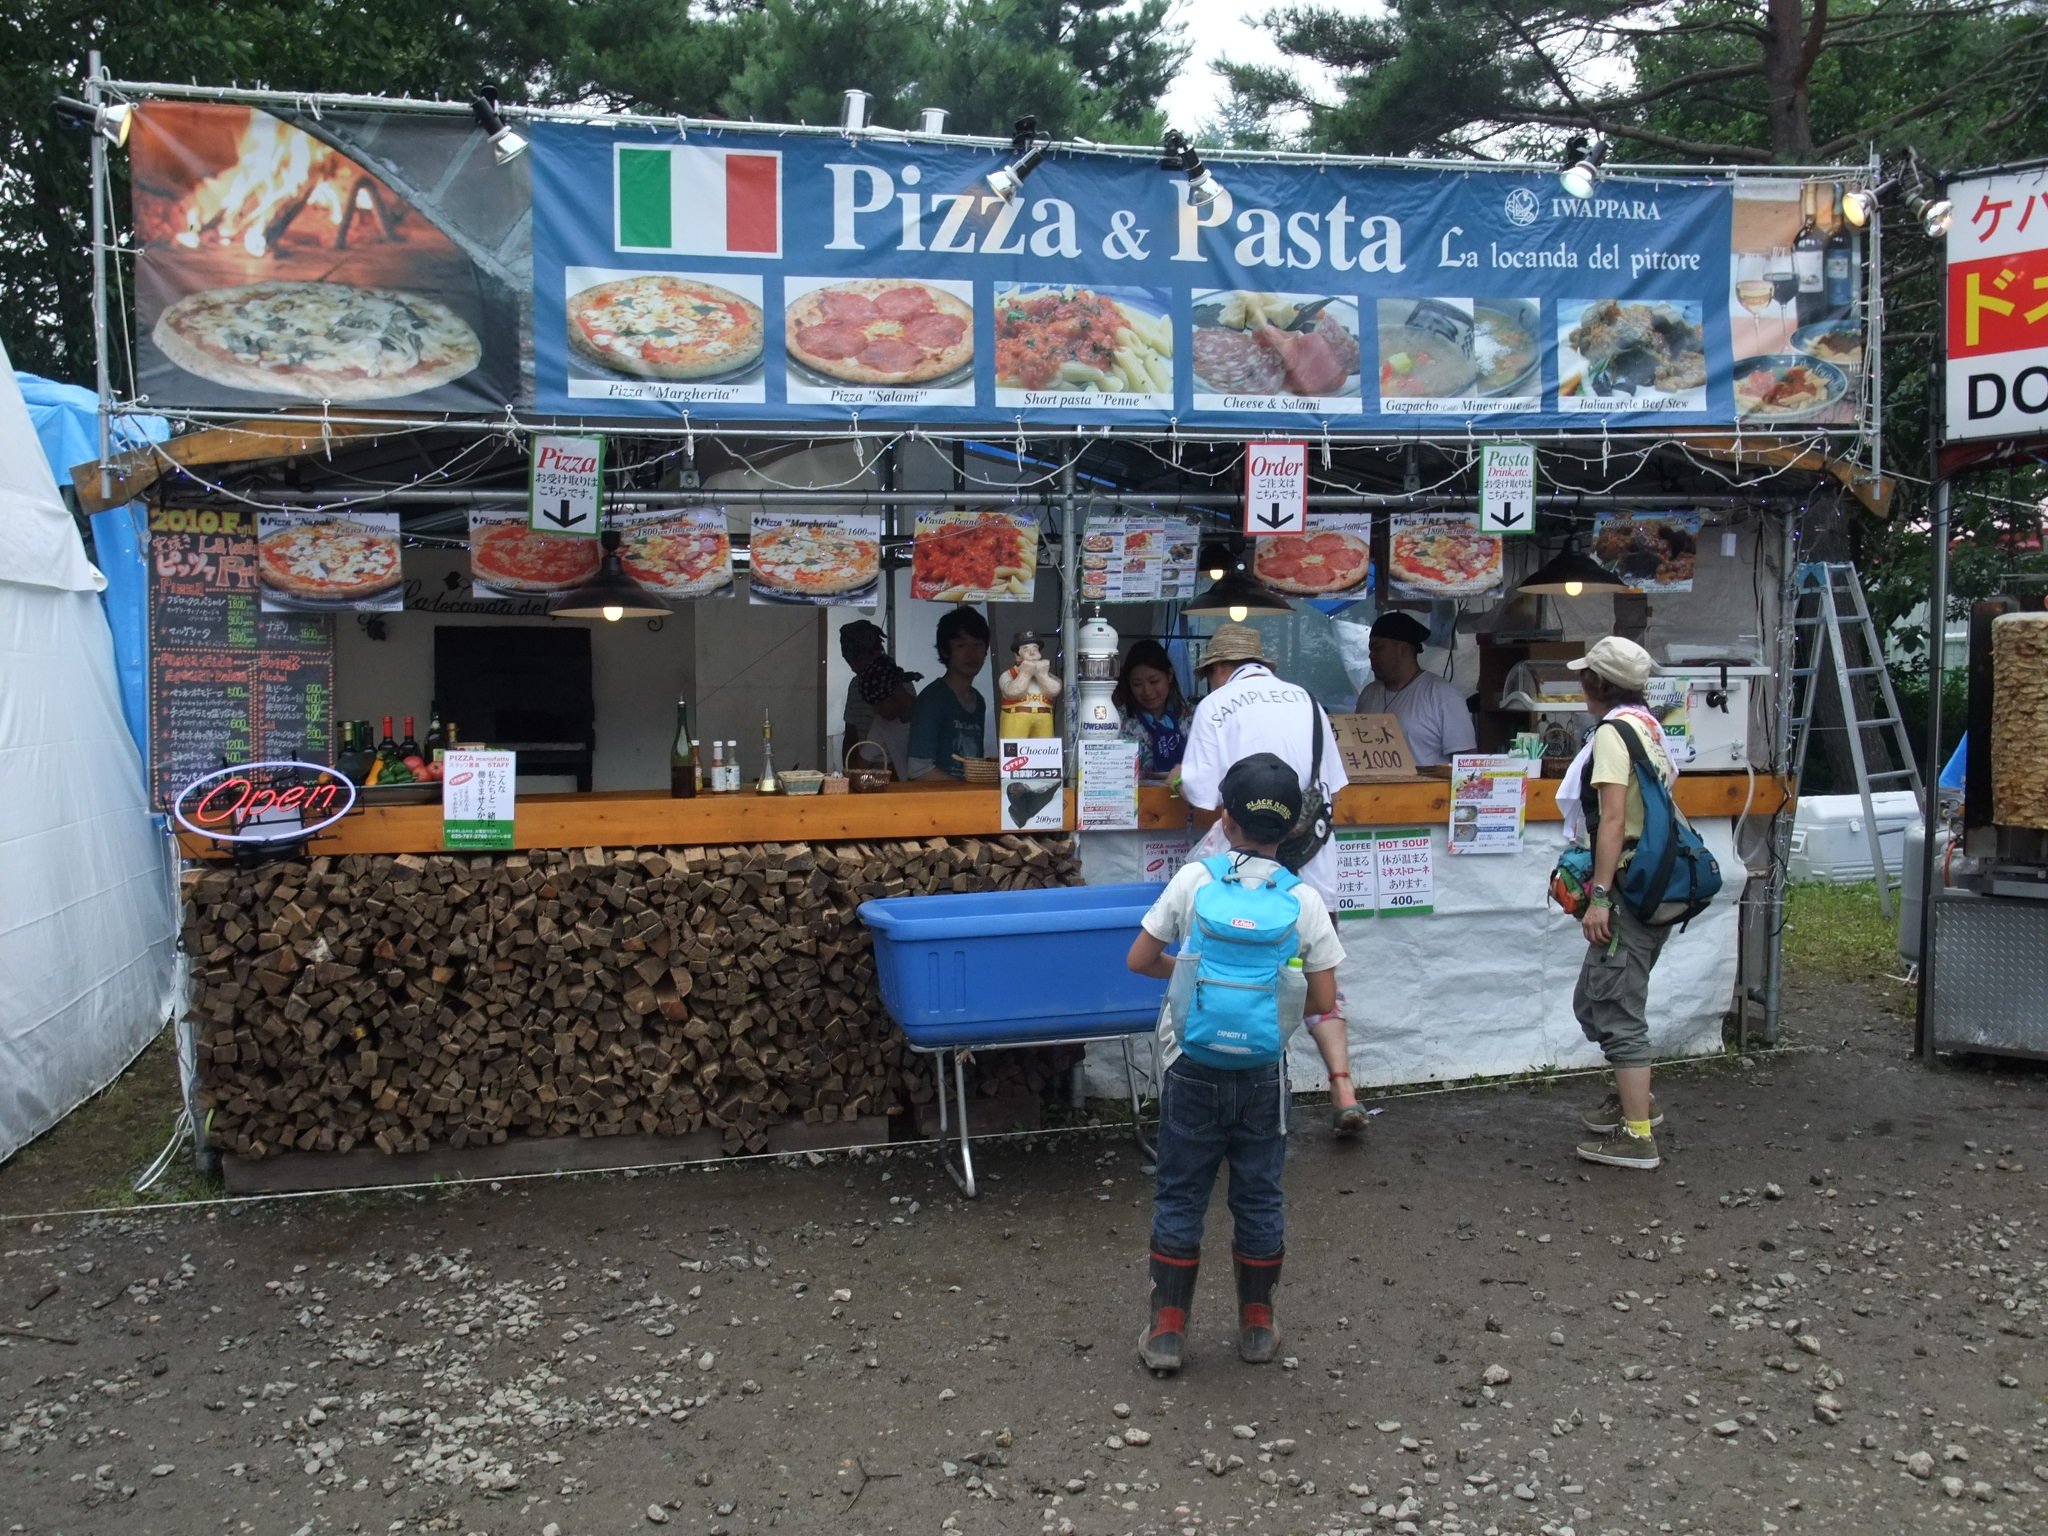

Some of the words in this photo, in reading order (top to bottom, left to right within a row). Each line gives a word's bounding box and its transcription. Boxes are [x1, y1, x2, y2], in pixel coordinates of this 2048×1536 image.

[1552, 198, 1661, 221] IWAPPARA
[824, 162, 1082, 259] Pizza
[1102, 209, 1152, 262] &
[1169, 179, 1406, 273] Pasta
[1438, 226, 1479, 270] La
[1491, 243, 1578, 270] locanda
[1588, 243, 1620, 270] del
[1631, 243, 1701, 278] pittore
[609, 383, 643, 399] Pizza
[648, 384, 740, 402] "Margherita"
[830, 390, 864, 402] Pizza
[868, 390, 928, 405] "Salami"
[1024, 393, 1057, 405] Short
[1060, 395, 1092, 408] pasta
[1223, 397, 1264, 410] Cheese
[1268, 398, 1277, 410] &
[1281, 398, 1321, 412] Salami
[1385, 399, 1439, 413] Gazpacho
[1461, 400, 1522, 413] Minestrone
[1579, 398, 1612, 410] Italian
[1615, 398, 1638, 412] style
[1642, 398, 1665, 410] Beef
[1667, 399, 1689, 411] Stew
[537, 447, 597, 474] Pizza
[1251, 456, 1303, 476] Order
[1487, 451, 1530, 468] Pasta
[535, 473, 598, 487] お受け取りは
[1258, 478, 1295, 489] ご注文は
[1484, 479, 1532, 489] お受け取りは
[539, 485, 593, 500] こちらです。
[1255, 489, 1301, 500] こちらです。
[1487, 489, 1529, 500] こちらです。
[267, 517, 291, 526] Pizza
[479, 516, 503, 525] Pizza
[760, 518, 782, 527] Pizza
[925, 516, 946, 525] Pasta
[432, 591, 515, 614] locanda
[1646, 691, 1684, 705] ineapple
[1019, 746, 1059, 755] Chocolat
[1345, 750, 1402, 769] ¥1000
[197, 778, 336, 823] Open
[1246, 798, 1273, 810] BLACK
[1340, 843, 1371, 851] COFFEE
[1378, 840, 1398, 849] HOT
[1402, 838, 1429, 848] SOUP
[1382, 852, 1428, 865] 体が温まる
[1381, 865, 1430, 877] ミネストローネ
[1389, 878, 1427, 890] あります。
[1391, 895, 1423, 906] 400yen
[1217, 1029, 1241, 1039] CAPACITY
